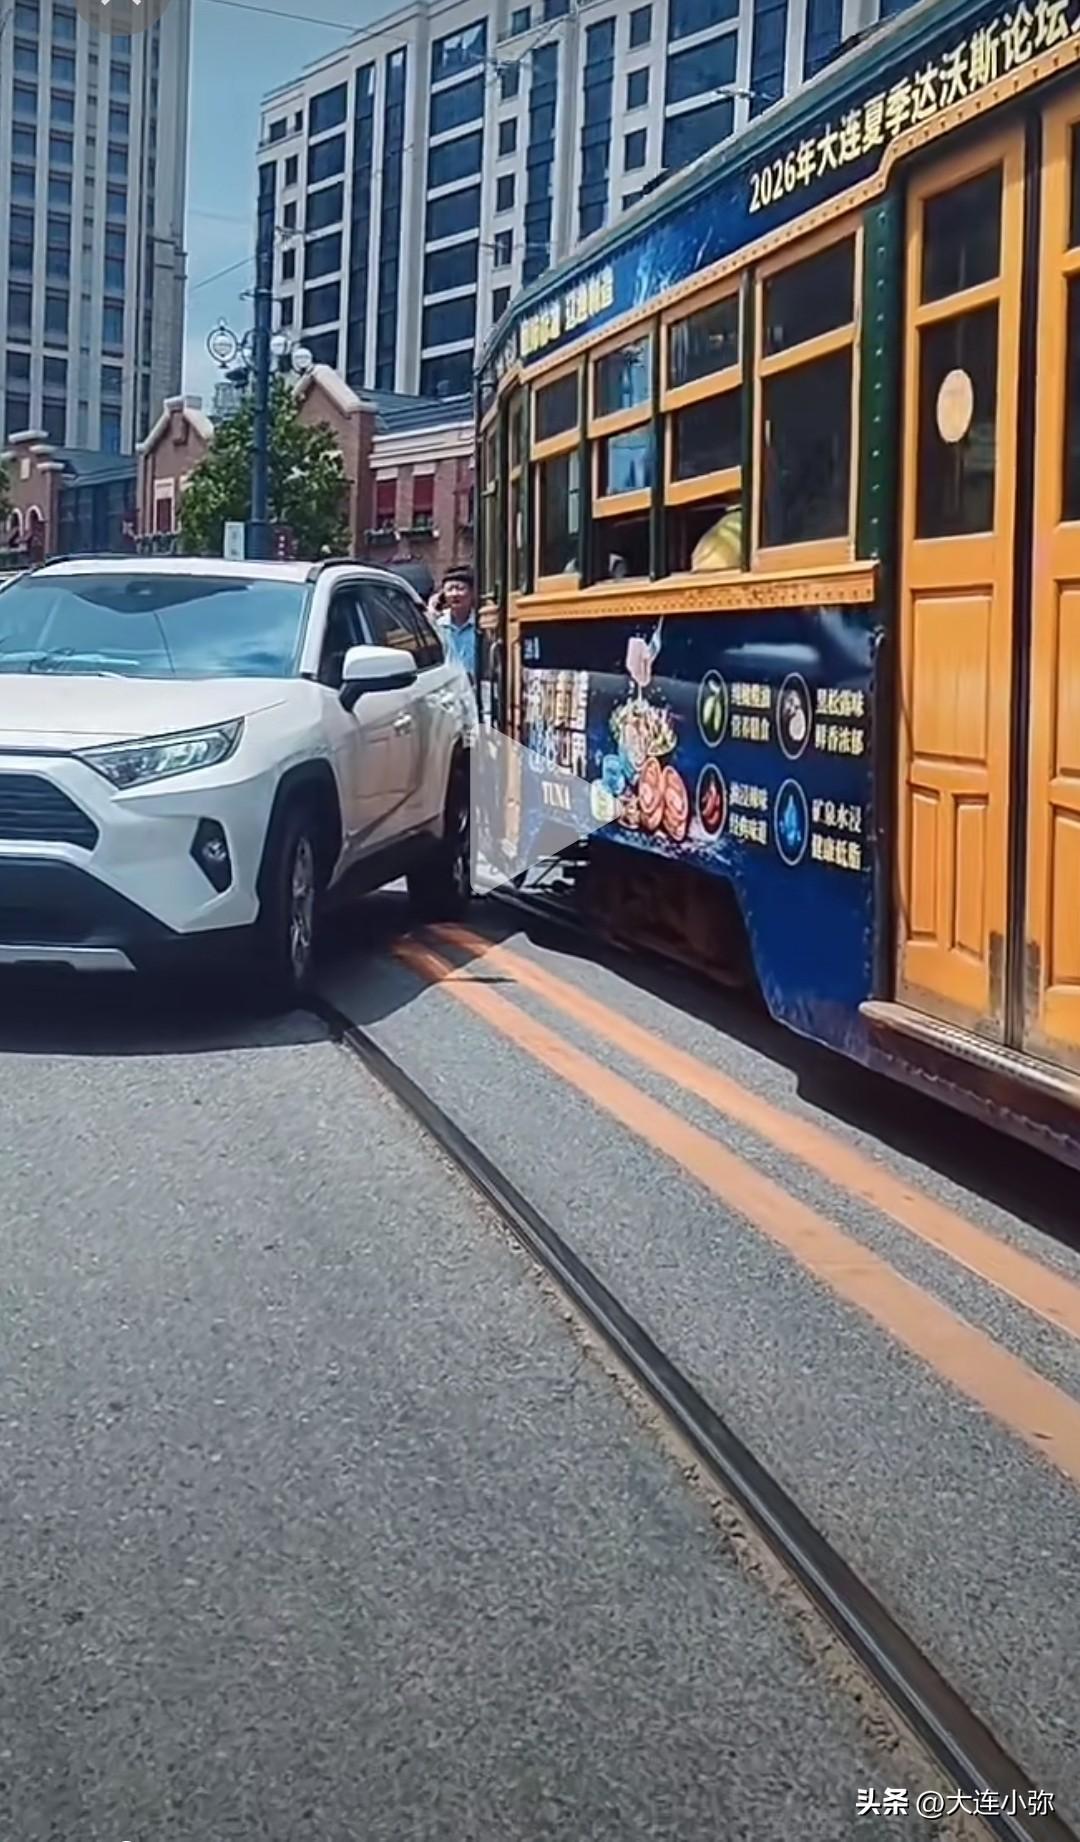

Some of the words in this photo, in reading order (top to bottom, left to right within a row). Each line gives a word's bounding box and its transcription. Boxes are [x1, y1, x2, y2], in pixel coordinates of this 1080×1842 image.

[748, 0, 1080, 213] 2026年大连夏季达沃斯论坛
[812, 798, 862, 833] 矿泉水浸
